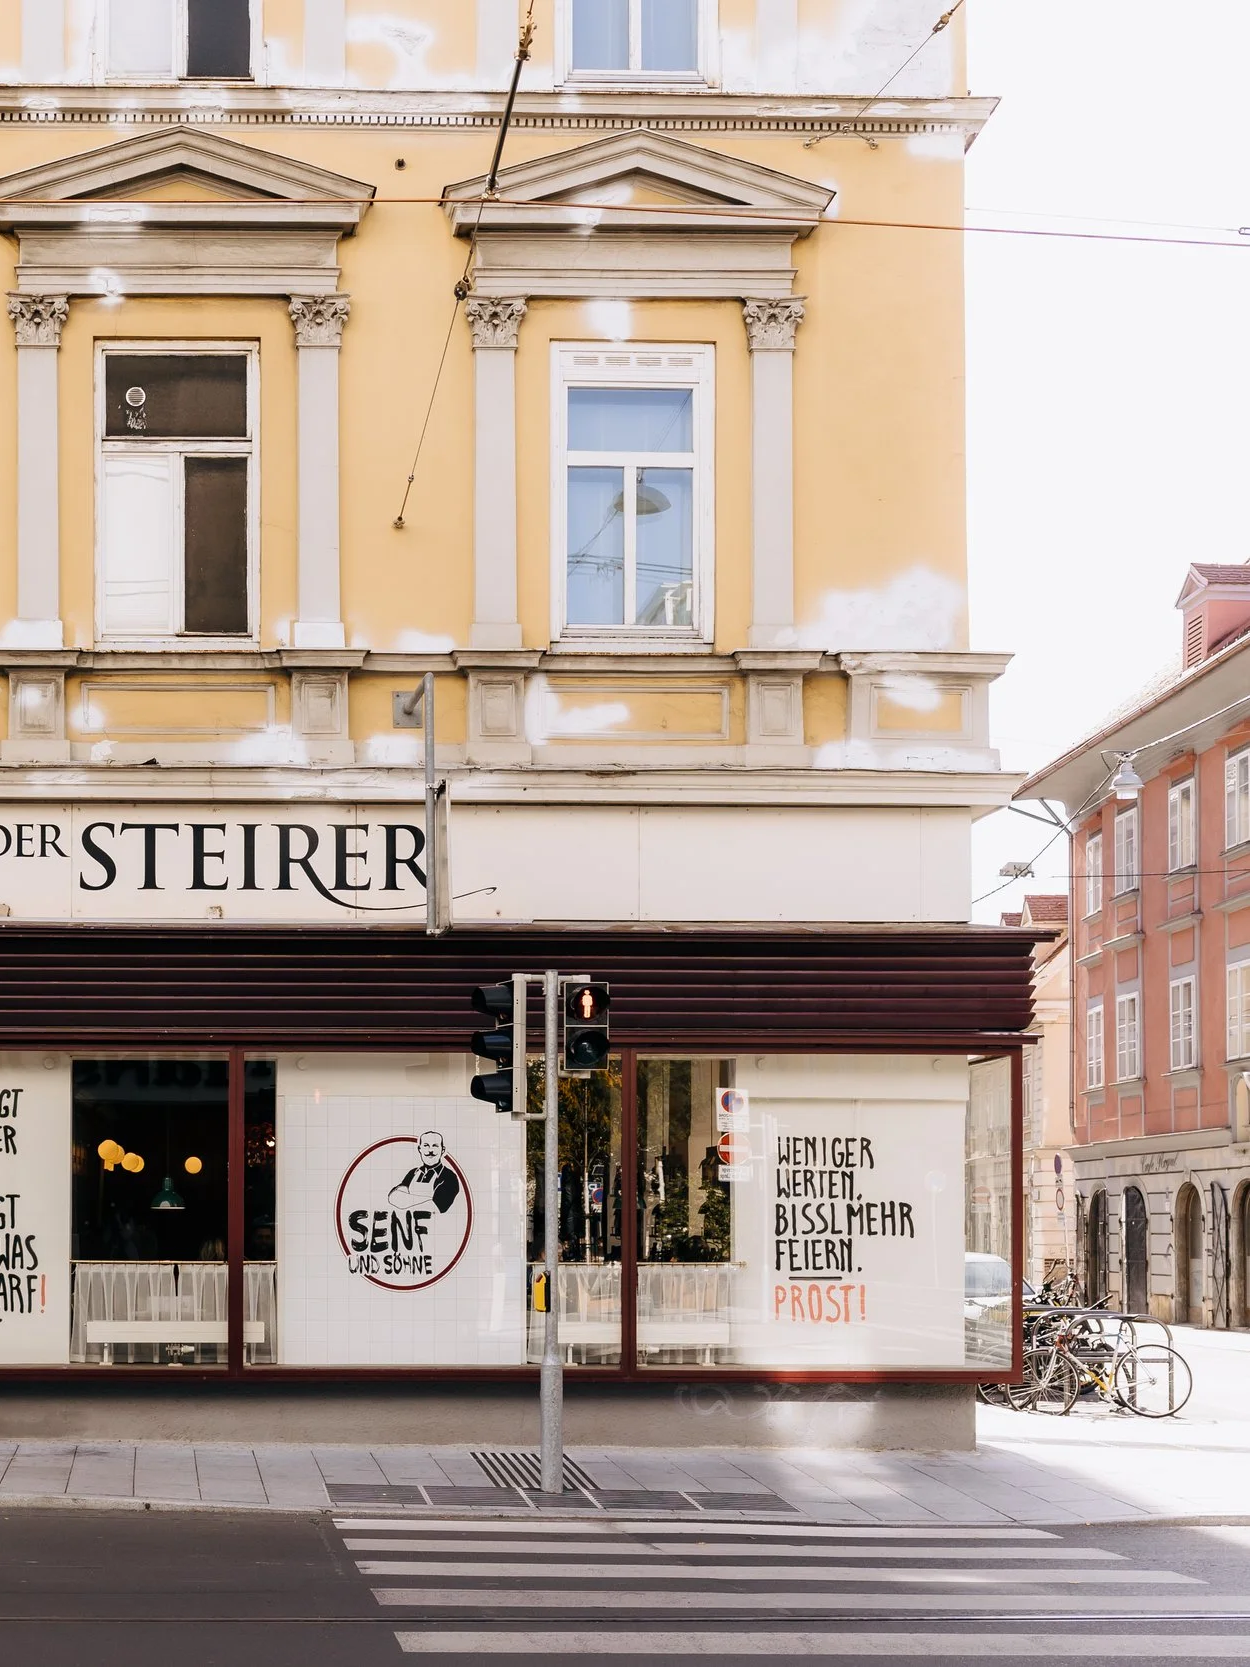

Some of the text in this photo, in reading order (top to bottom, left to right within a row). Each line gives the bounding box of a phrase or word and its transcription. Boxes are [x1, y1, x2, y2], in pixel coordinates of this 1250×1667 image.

[80, 822, 430, 911] STEIRER
[777, 1136, 874, 1169] WENIGER
[349, 1210, 432, 1253] SENF
[775, 1201, 915, 1239] BISSL MEHR
[348, 1252, 432, 1275] UND SÖHNE
[775, 1238, 863, 1273] FEIERN.
[775, 1284, 866, 1324] PROST!
